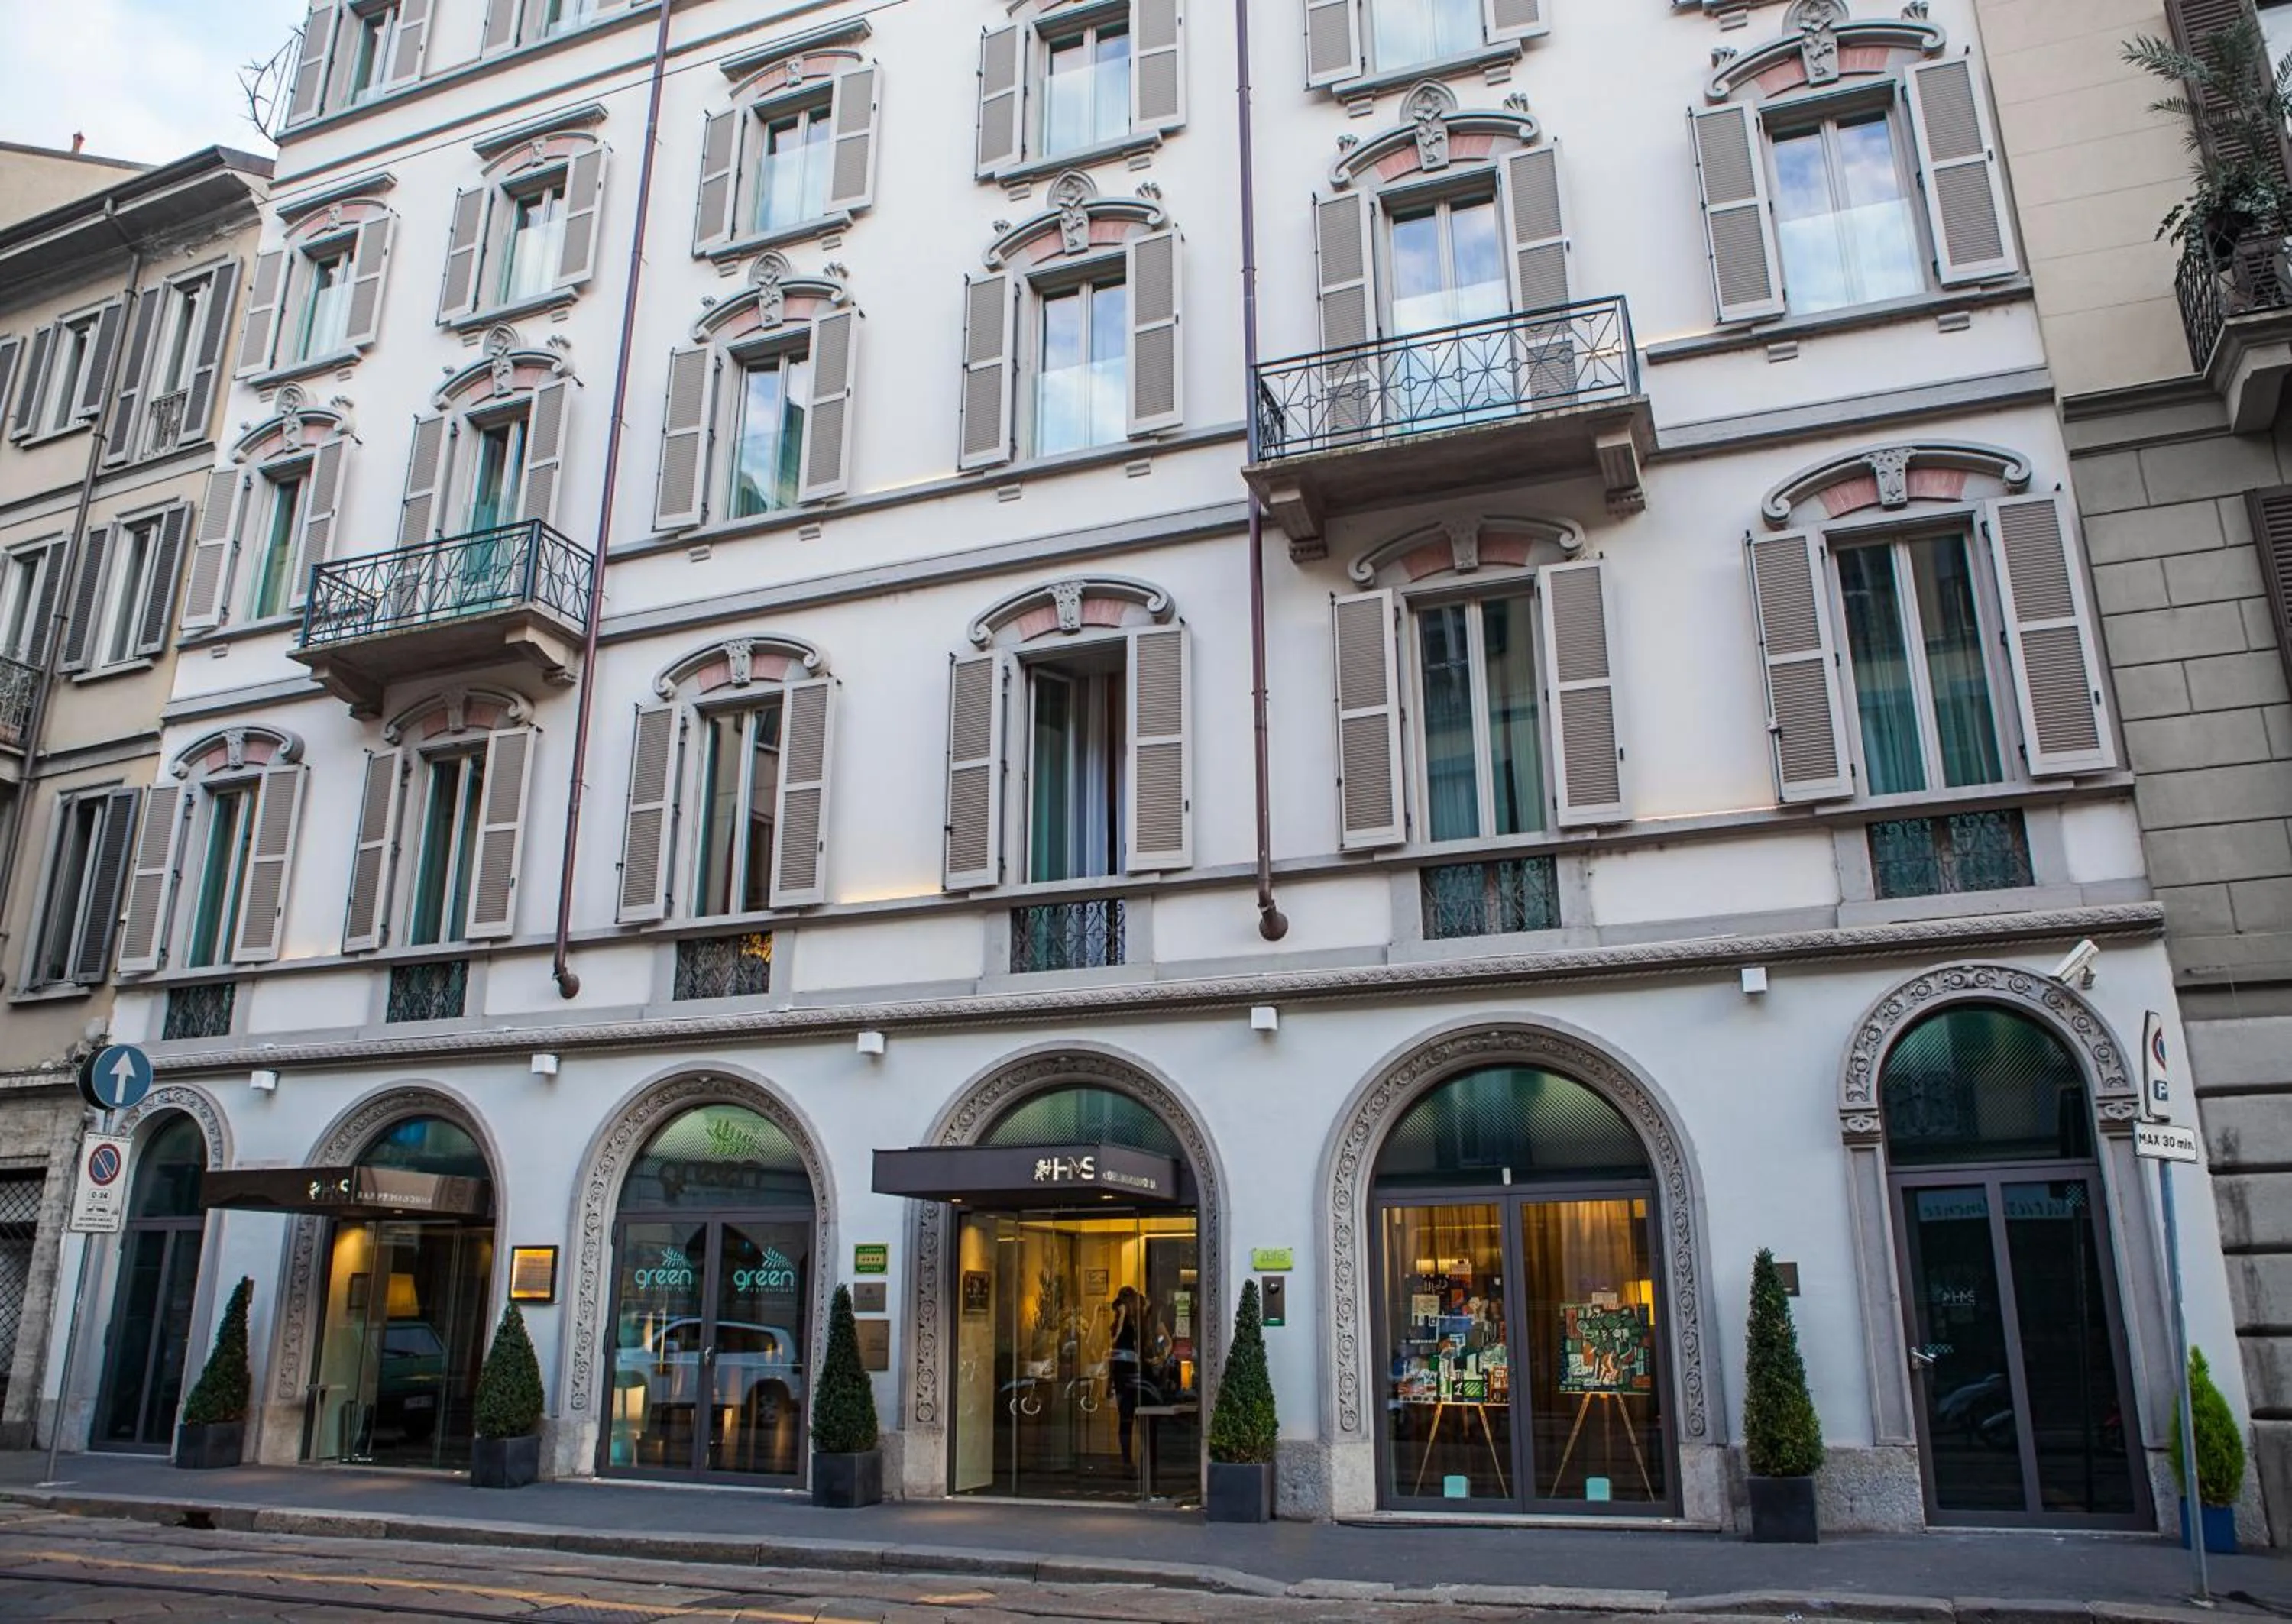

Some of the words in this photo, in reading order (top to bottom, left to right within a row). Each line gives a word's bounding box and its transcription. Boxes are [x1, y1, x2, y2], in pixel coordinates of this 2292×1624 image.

[2139, 1133, 2160, 1146] MAX
[2162, 1136, 2175, 1148] 30
[2177, 1139, 2195, 1151] min.
[1053, 1155, 1095, 1181] HMS
[635, 1269, 691, 1290] green
[733, 1269, 794, 1291] green
